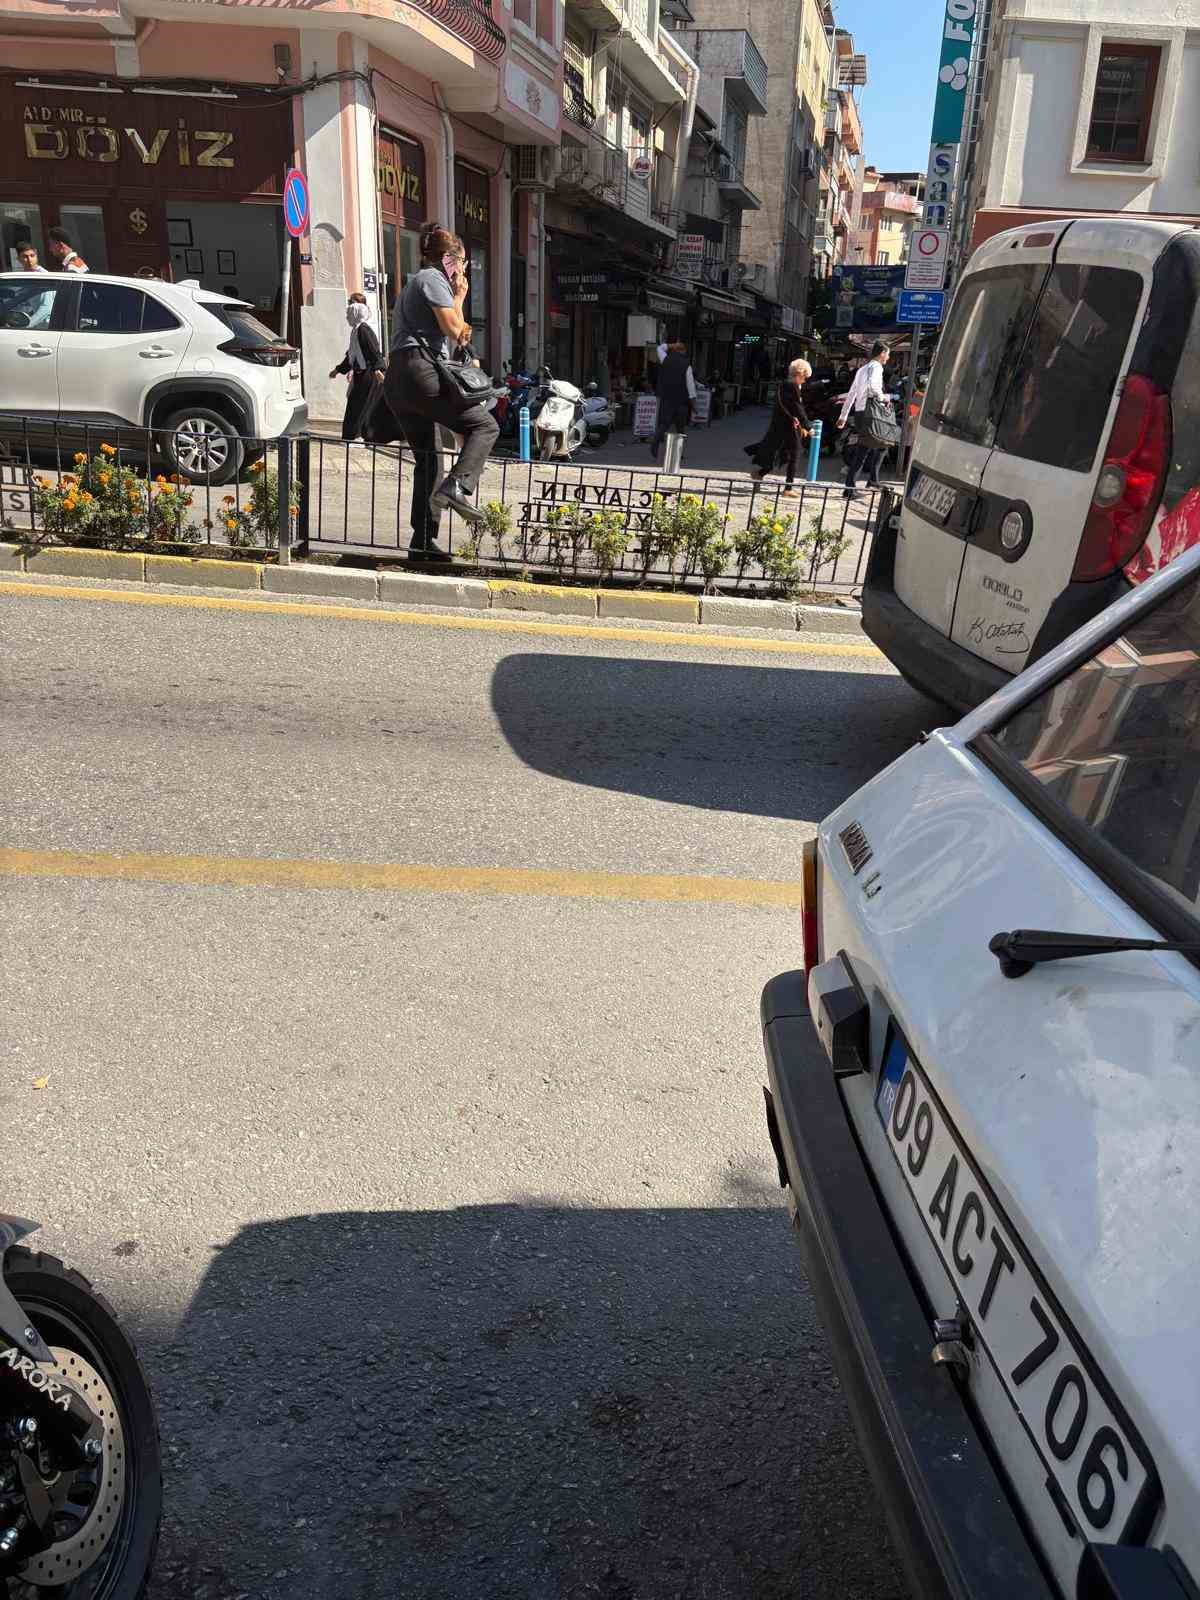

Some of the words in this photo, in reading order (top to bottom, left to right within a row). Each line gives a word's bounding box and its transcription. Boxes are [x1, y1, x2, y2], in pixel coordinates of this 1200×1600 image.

[24, 115, 235, 168] DÖVİZ
[891, 1070, 934, 1177] 09
[928, 1154, 1016, 1320] ACT
[1010, 1295, 1129, 1530] 706
